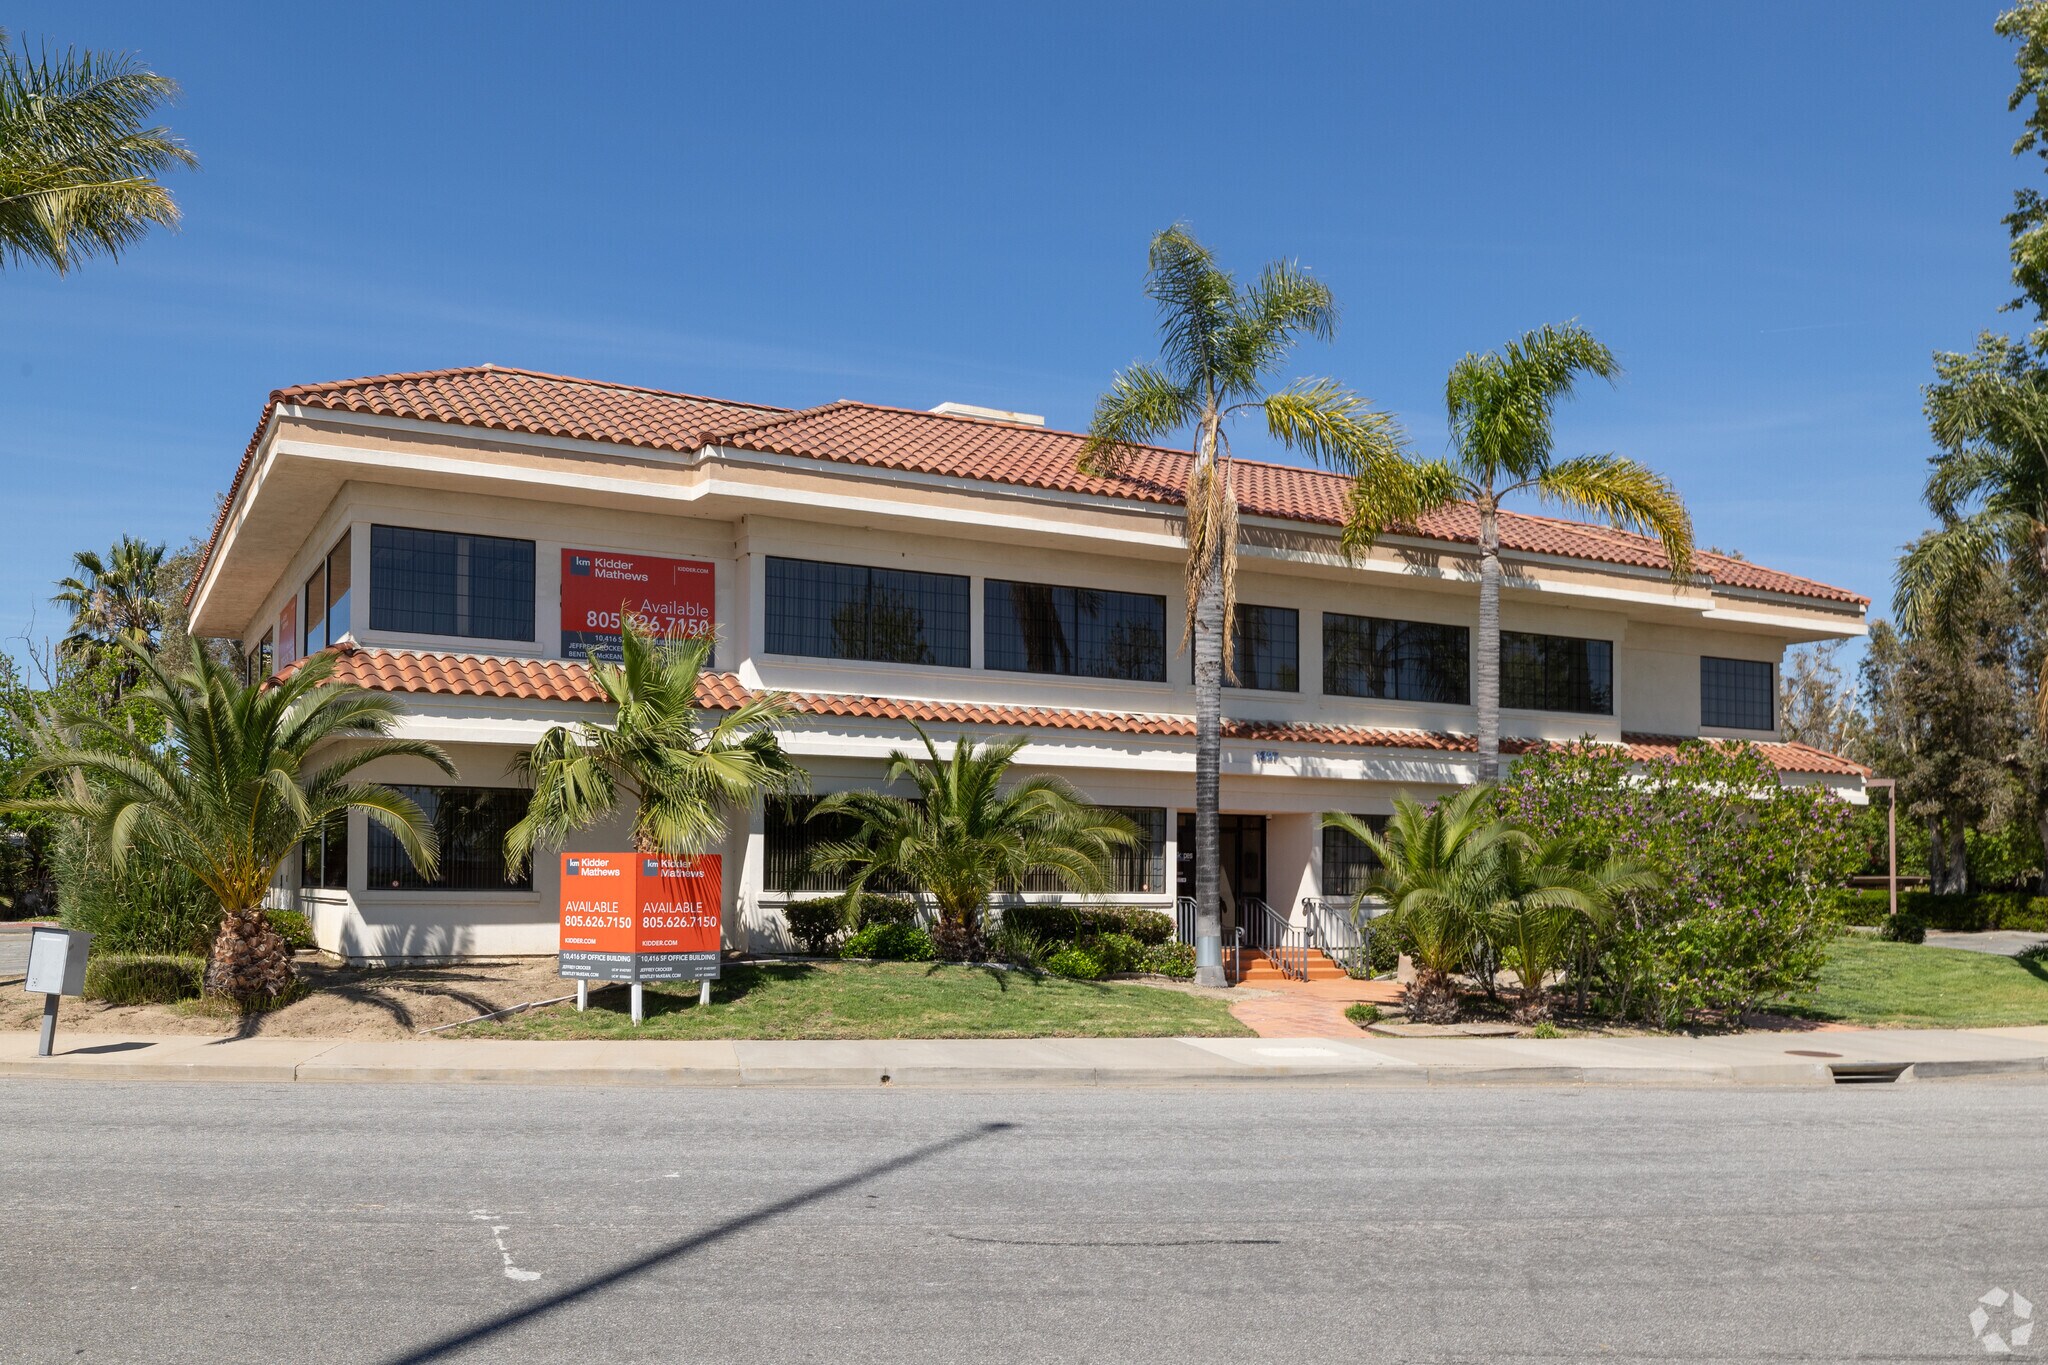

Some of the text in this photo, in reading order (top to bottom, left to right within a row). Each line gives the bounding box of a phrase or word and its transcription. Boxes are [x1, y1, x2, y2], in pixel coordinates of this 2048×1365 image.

[576, 556, 633, 570] km Kidder
[595, 568, 648, 582] Mathews
[678, 566, 709, 574] KIDDER.COM
[640, 598, 709, 617] Available
[586, 610, 709, 635] 805626.7150
[595, 635, 617, 643] 10,416
[568, 650, 595, 658] BENTL
[581, 858, 610, 867] Kidder
[661, 859, 692, 868] Kidder
[581, 868, 620, 876] Mathews
[660, 868, 704, 878] Mathews
[566, 900, 619, 913] AVAILABLE
[642, 902, 703, 914] AVAILABLE
[564, 915, 632, 928] 805.626.7150
[642, 916, 717, 928] 805.626.7150
[668, 954, 688, 962] OFFICE
